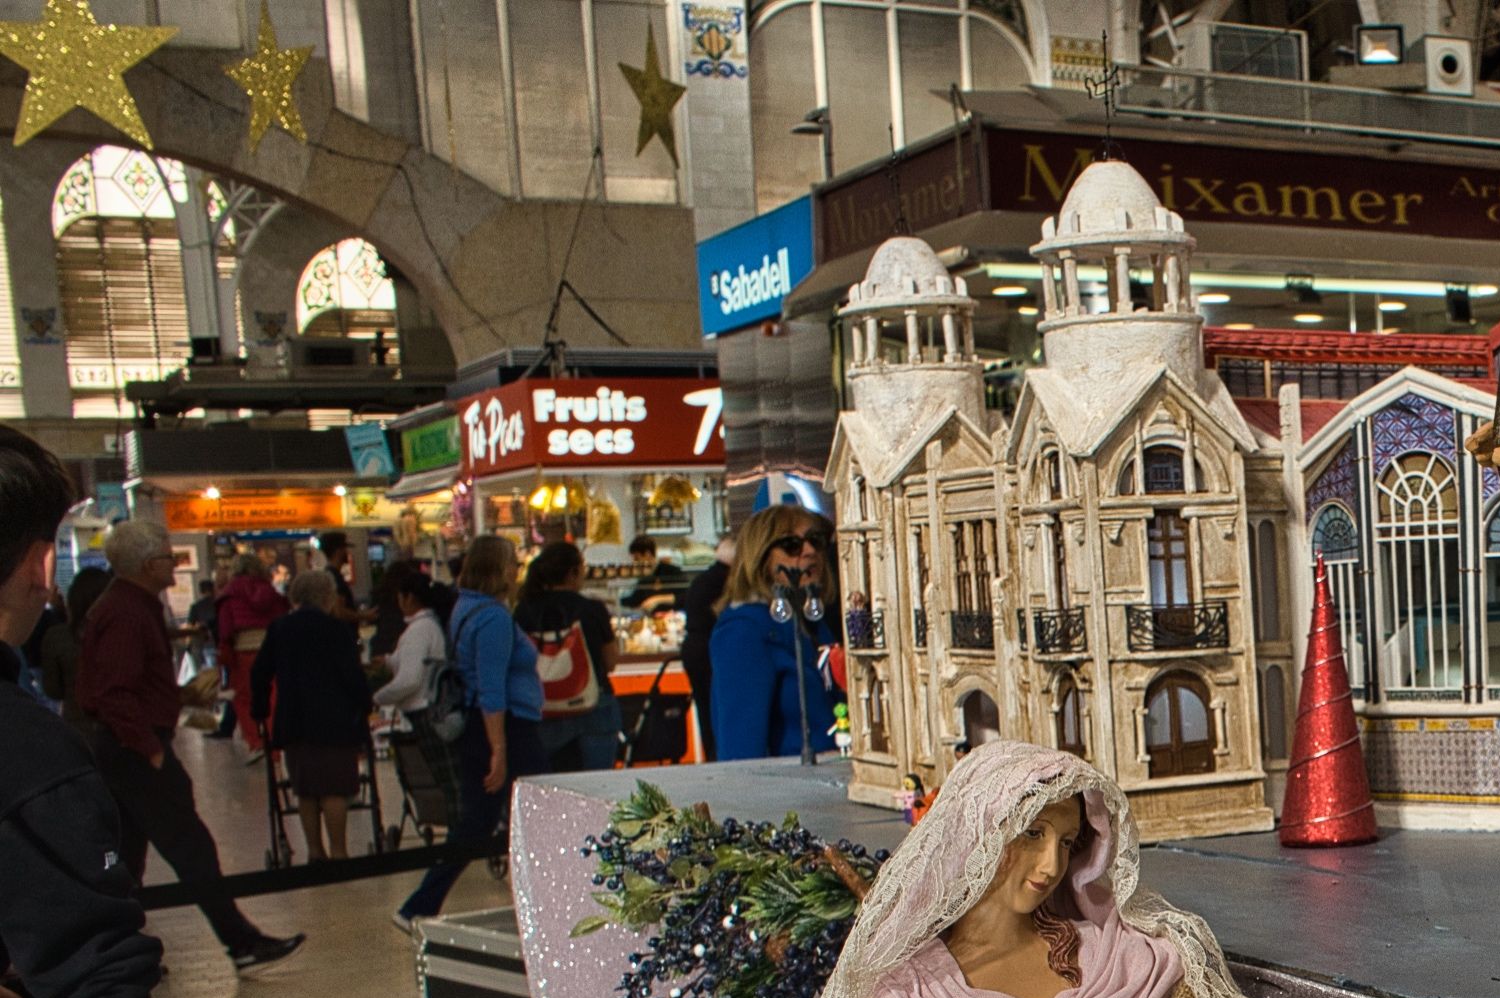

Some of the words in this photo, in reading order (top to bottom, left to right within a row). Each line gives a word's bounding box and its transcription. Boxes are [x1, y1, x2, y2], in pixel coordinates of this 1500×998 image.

[1018, 144, 1423, 225] Mixamer
[719, 247, 792, 316] Sabadell
[532, 386, 648, 423] Fruits
[547, 428, 636, 456] secs
